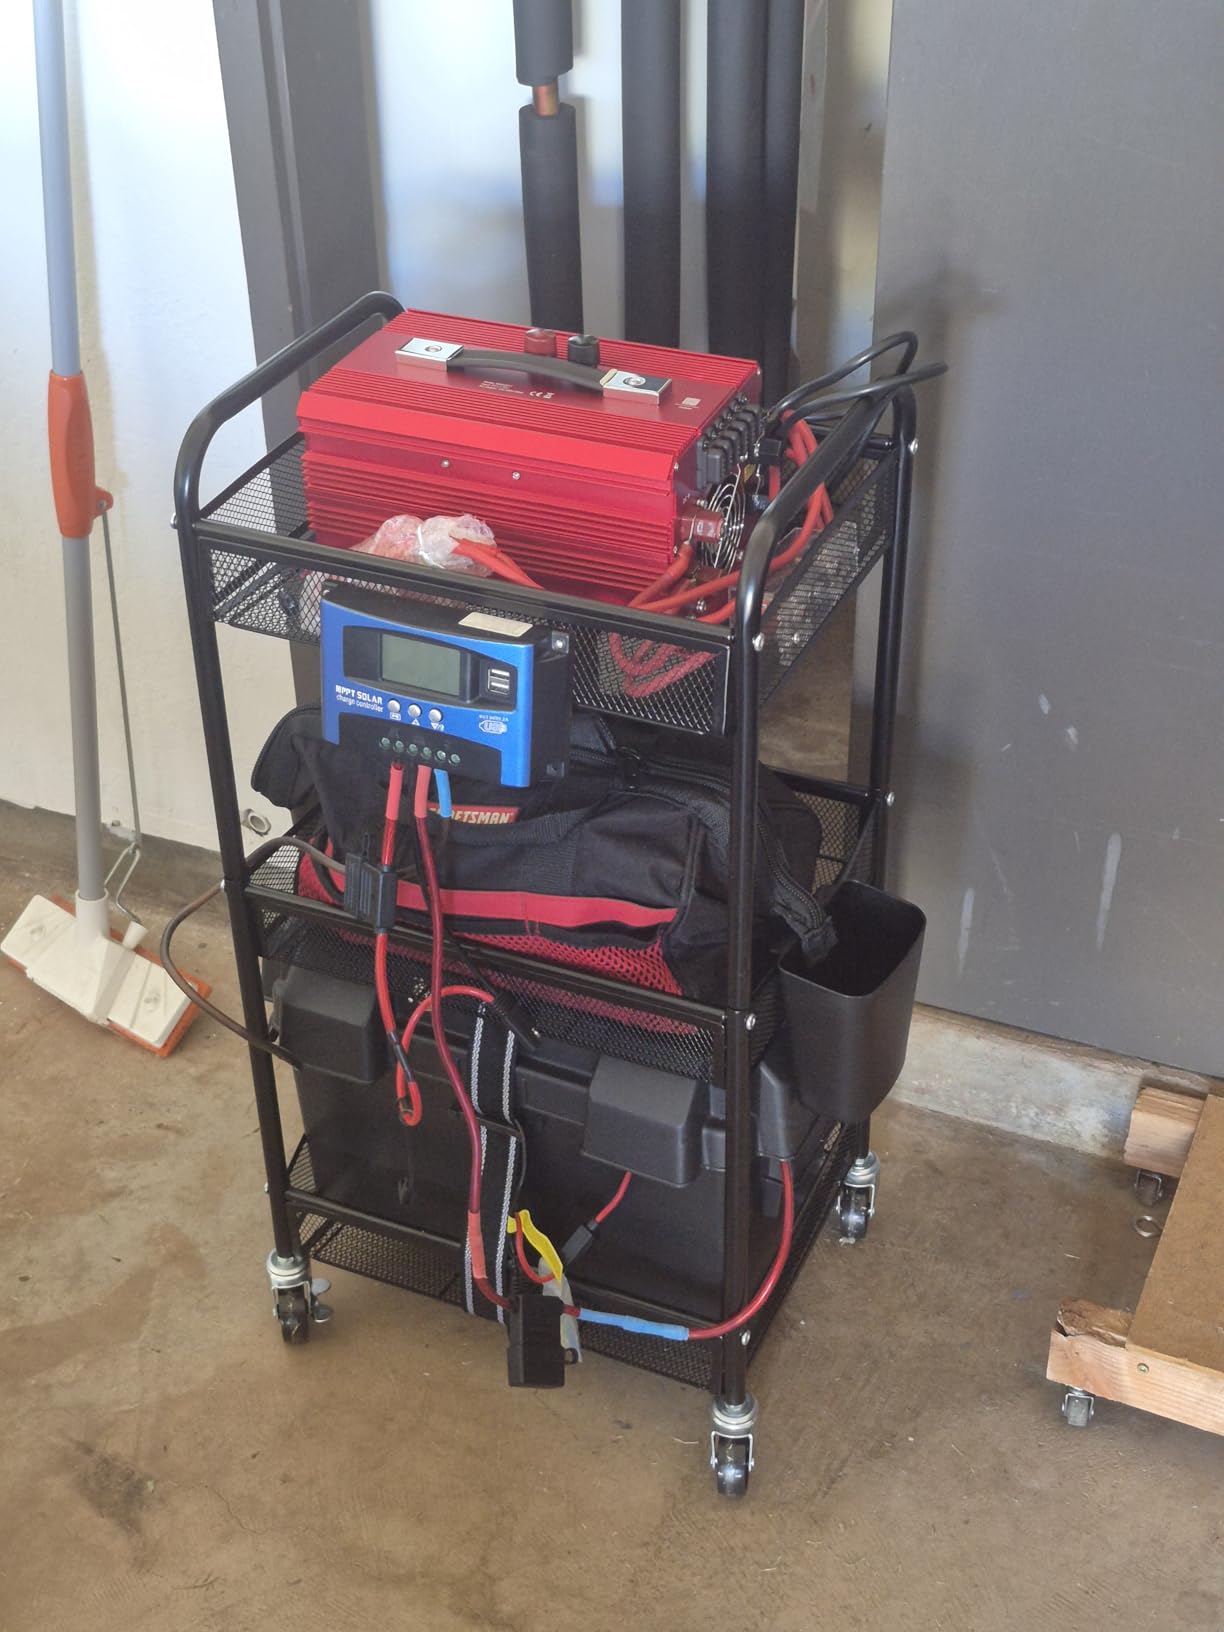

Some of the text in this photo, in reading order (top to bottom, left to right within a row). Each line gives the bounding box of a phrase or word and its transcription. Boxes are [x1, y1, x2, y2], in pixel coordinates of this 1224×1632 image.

[335, 684, 383, 705] MPPT SOLAR
[336, 694, 384, 713] charge controller
[429, 807, 511, 825] FTSMAN
